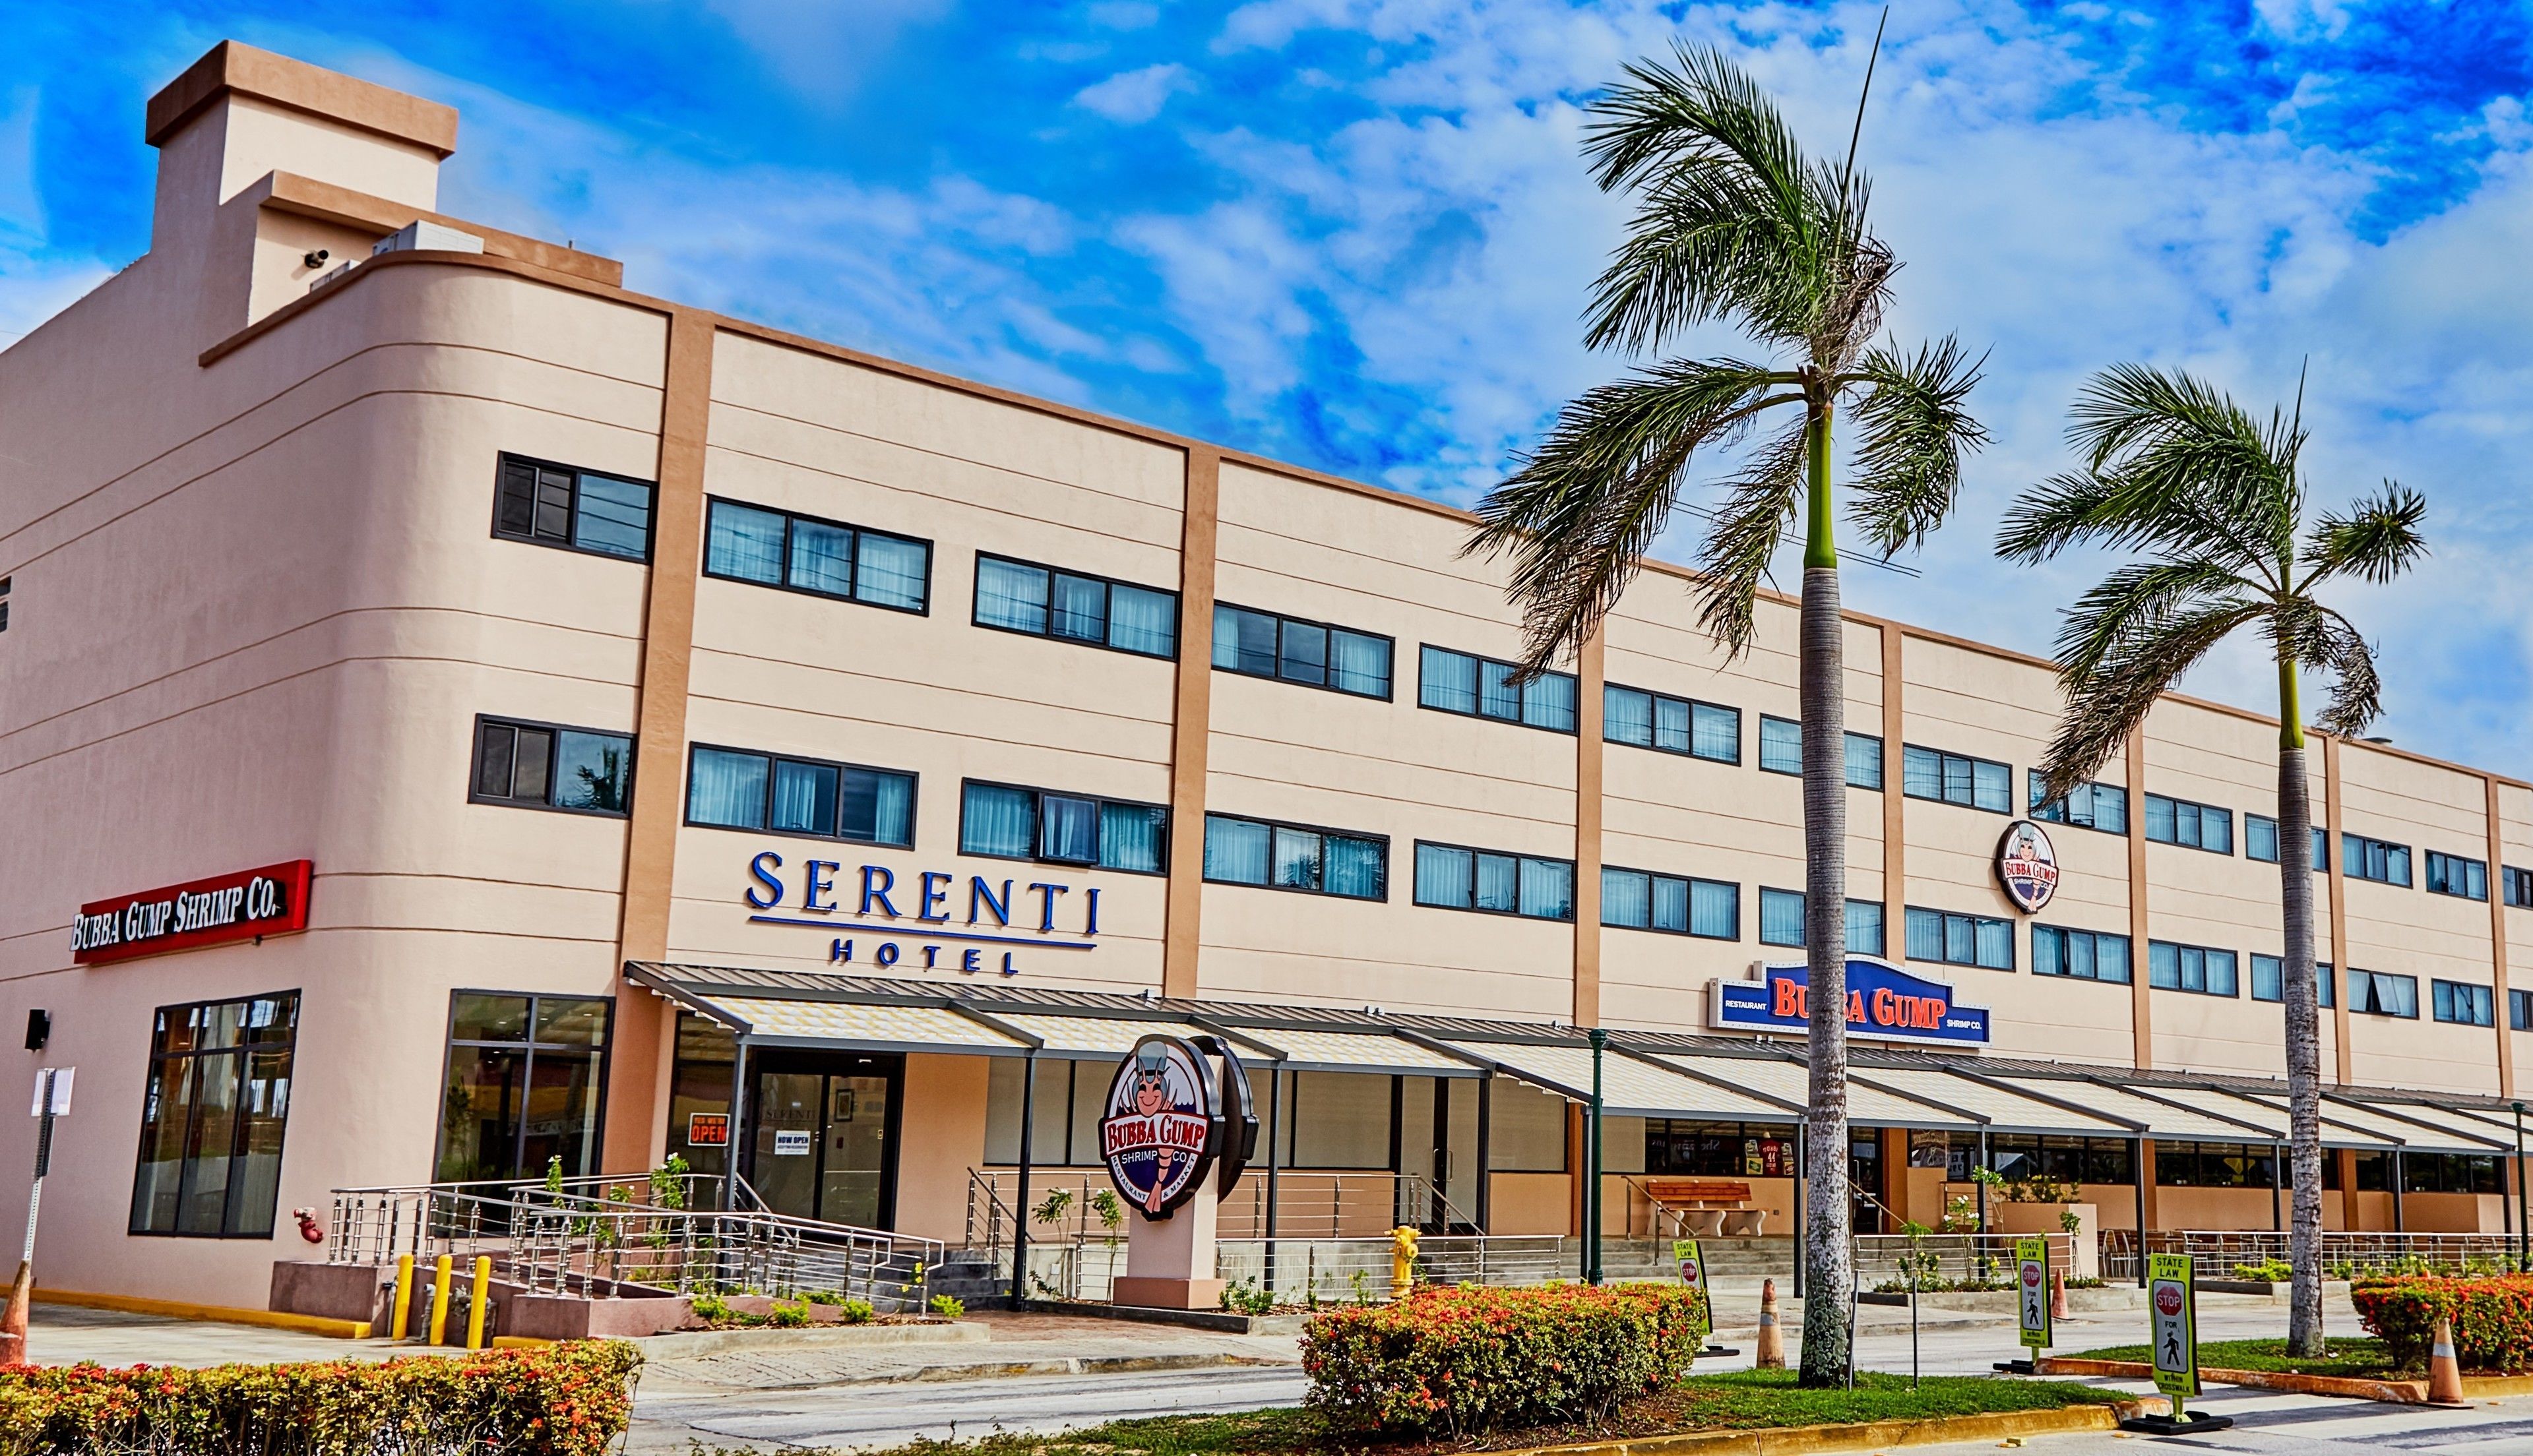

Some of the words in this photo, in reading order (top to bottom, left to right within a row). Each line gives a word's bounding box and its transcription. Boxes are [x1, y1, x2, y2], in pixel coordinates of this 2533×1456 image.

[2005, 861, 2031, 876] BUBBA
[2033, 863, 2056, 882] GUMP
[747, 851, 1101, 934] SERENTI
[69, 910, 119, 952] BUBBA
[125, 901, 172, 942] GUMP
[173, 886, 243, 933] SHRIMP
[247, 876, 276, 921] CO.
[832, 938, 1018, 974] HOTEL
[1725, 1000, 1767, 1010] RESTAURANT
[1774, 977, 1867, 1023] BUA
[1874, 987, 1947, 1029] GUMP
[1947, 1019, 1970, 1028] SHRIMP
[1970, 1021, 1982, 1029] CO.
[691, 1125, 726, 1141] OPEN
[1107, 1119, 1157, 1152] BUBBA
[1160, 1114, 1204, 1149] GUMP
[1121, 1150, 1158, 1165] SHRIMP
[1768, 1152, 1776, 1163] 44
[1112, 1156, 1146, 1200] RESTAURANT
[1170, 1155, 1195, 1194] MARKET
[2020, 1242, 2039, 1250] STATE
[2156, 1257, 2183, 1268] STATE
[2024, 1271, 2040, 1281] STOP
[2159, 1268, 2179, 1278] LAW
[2157, 1294, 2180, 1307] STOP
